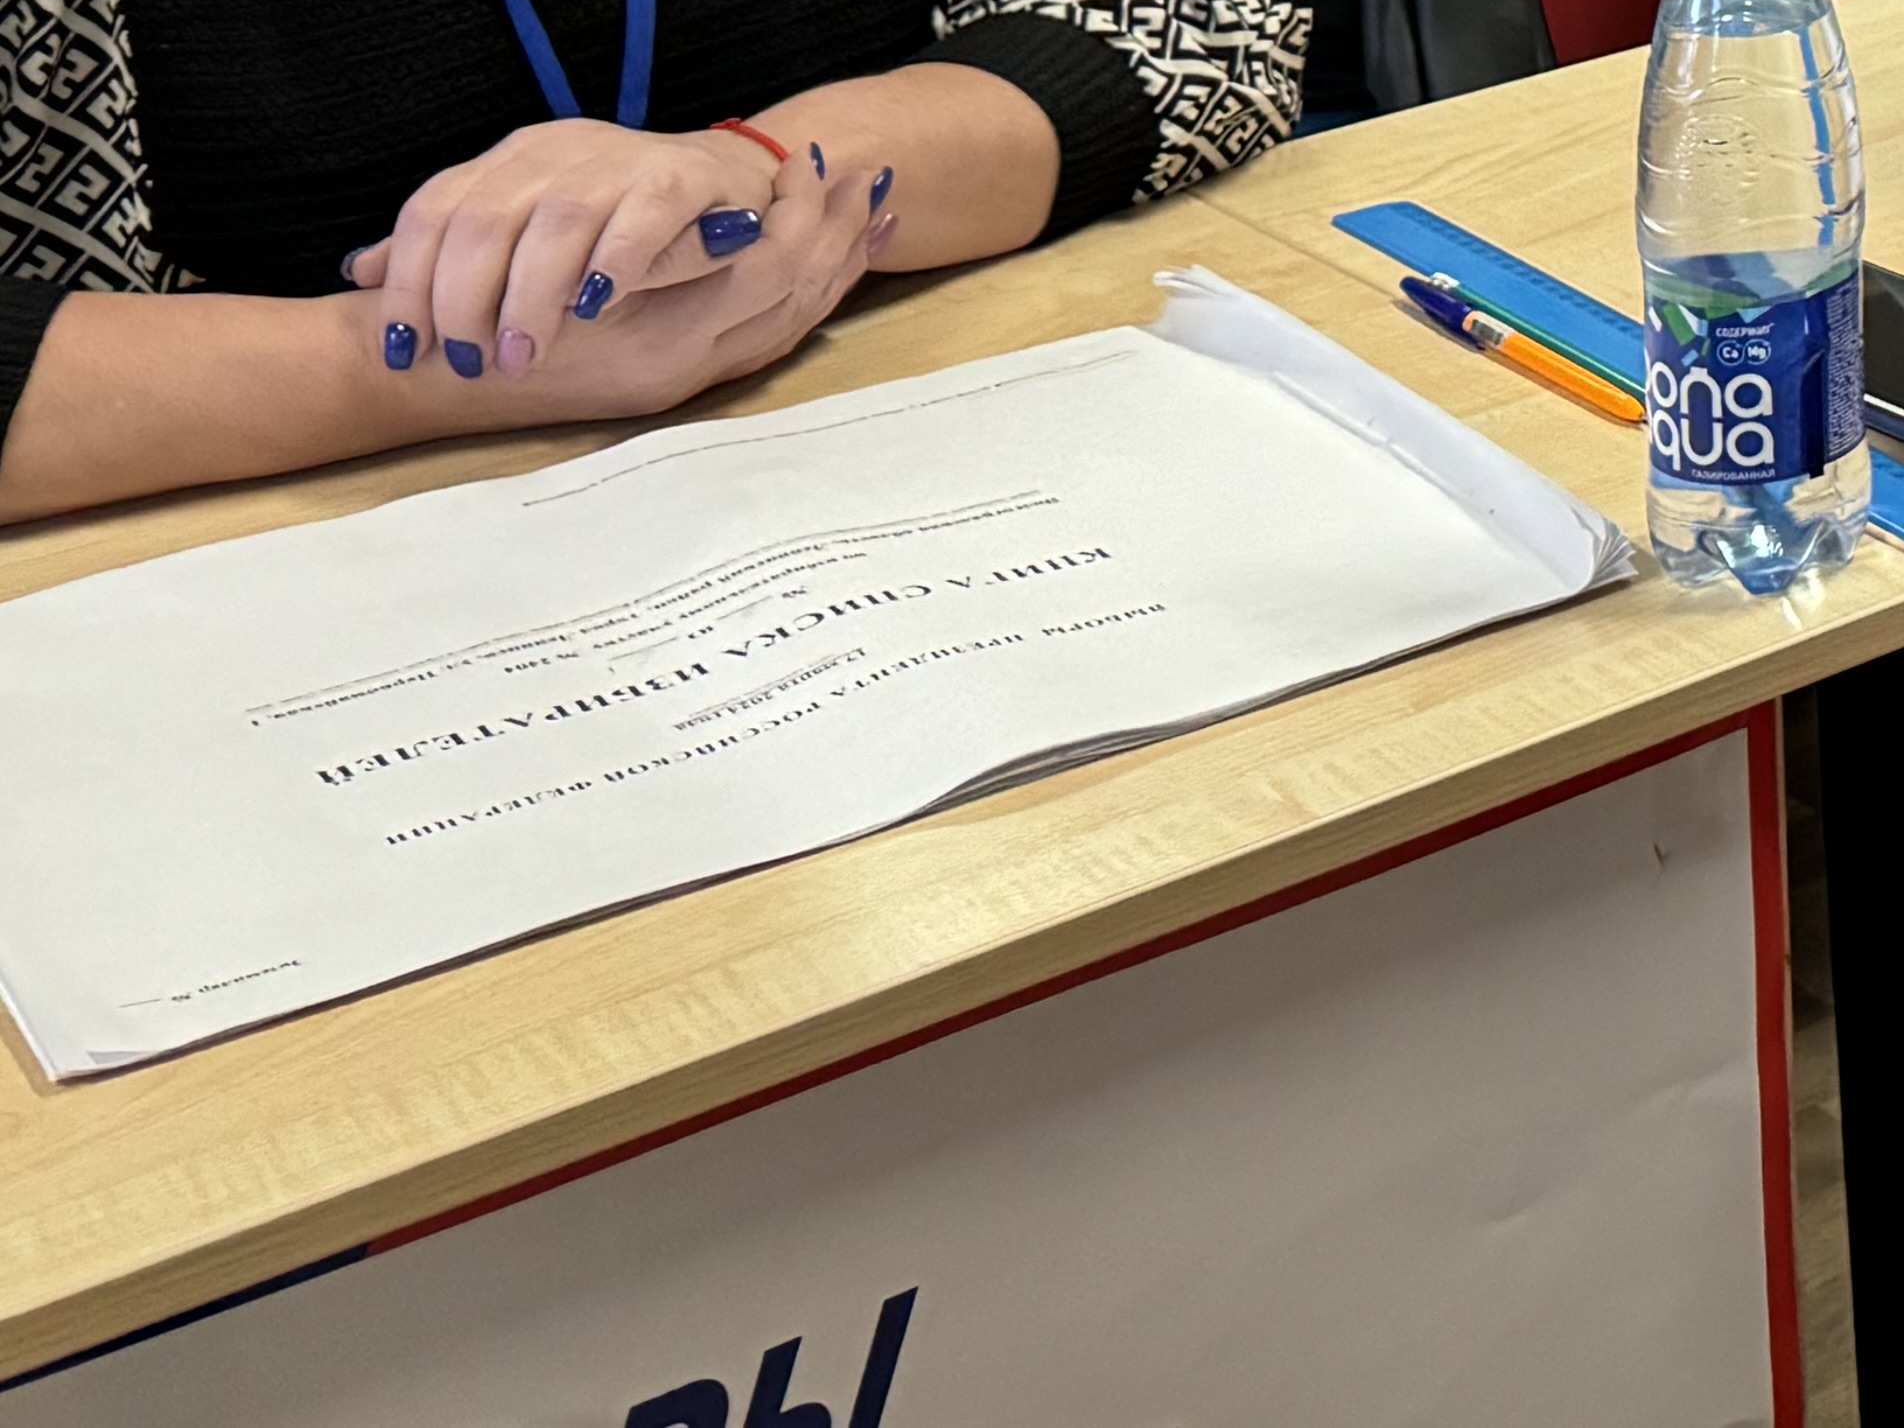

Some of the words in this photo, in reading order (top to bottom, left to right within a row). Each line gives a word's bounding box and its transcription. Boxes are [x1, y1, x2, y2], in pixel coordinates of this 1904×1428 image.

[945, 547, 1113, 588] КНИГА
[720, 584, 932, 658] СПИСКА
[315, 662, 711, 786] ИЗБИРАТЕЛЕЙ
[604, 701, 822, 783] РОССИЙСКОЙ
